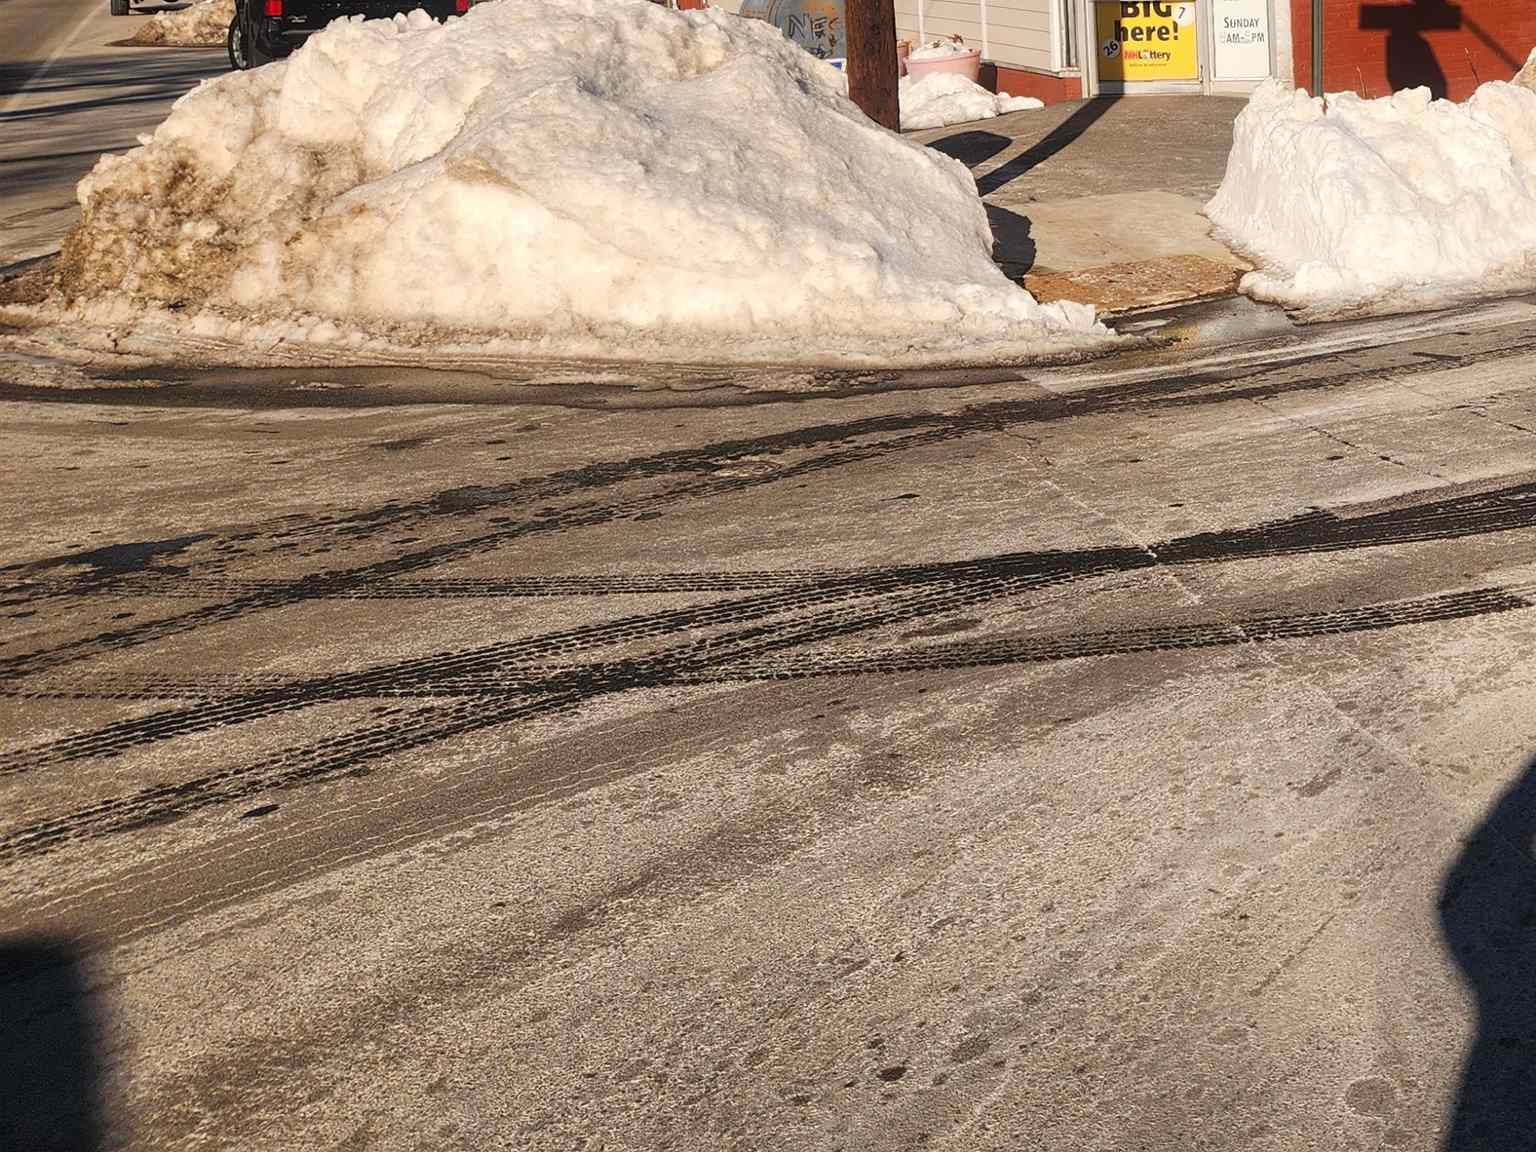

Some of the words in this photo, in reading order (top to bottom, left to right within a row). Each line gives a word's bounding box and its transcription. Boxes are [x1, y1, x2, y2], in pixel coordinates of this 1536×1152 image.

[1178, 6, 1186, 19] 7
[1114, 19, 1179, 42] here!
[1103, 40, 1119, 56] 26
